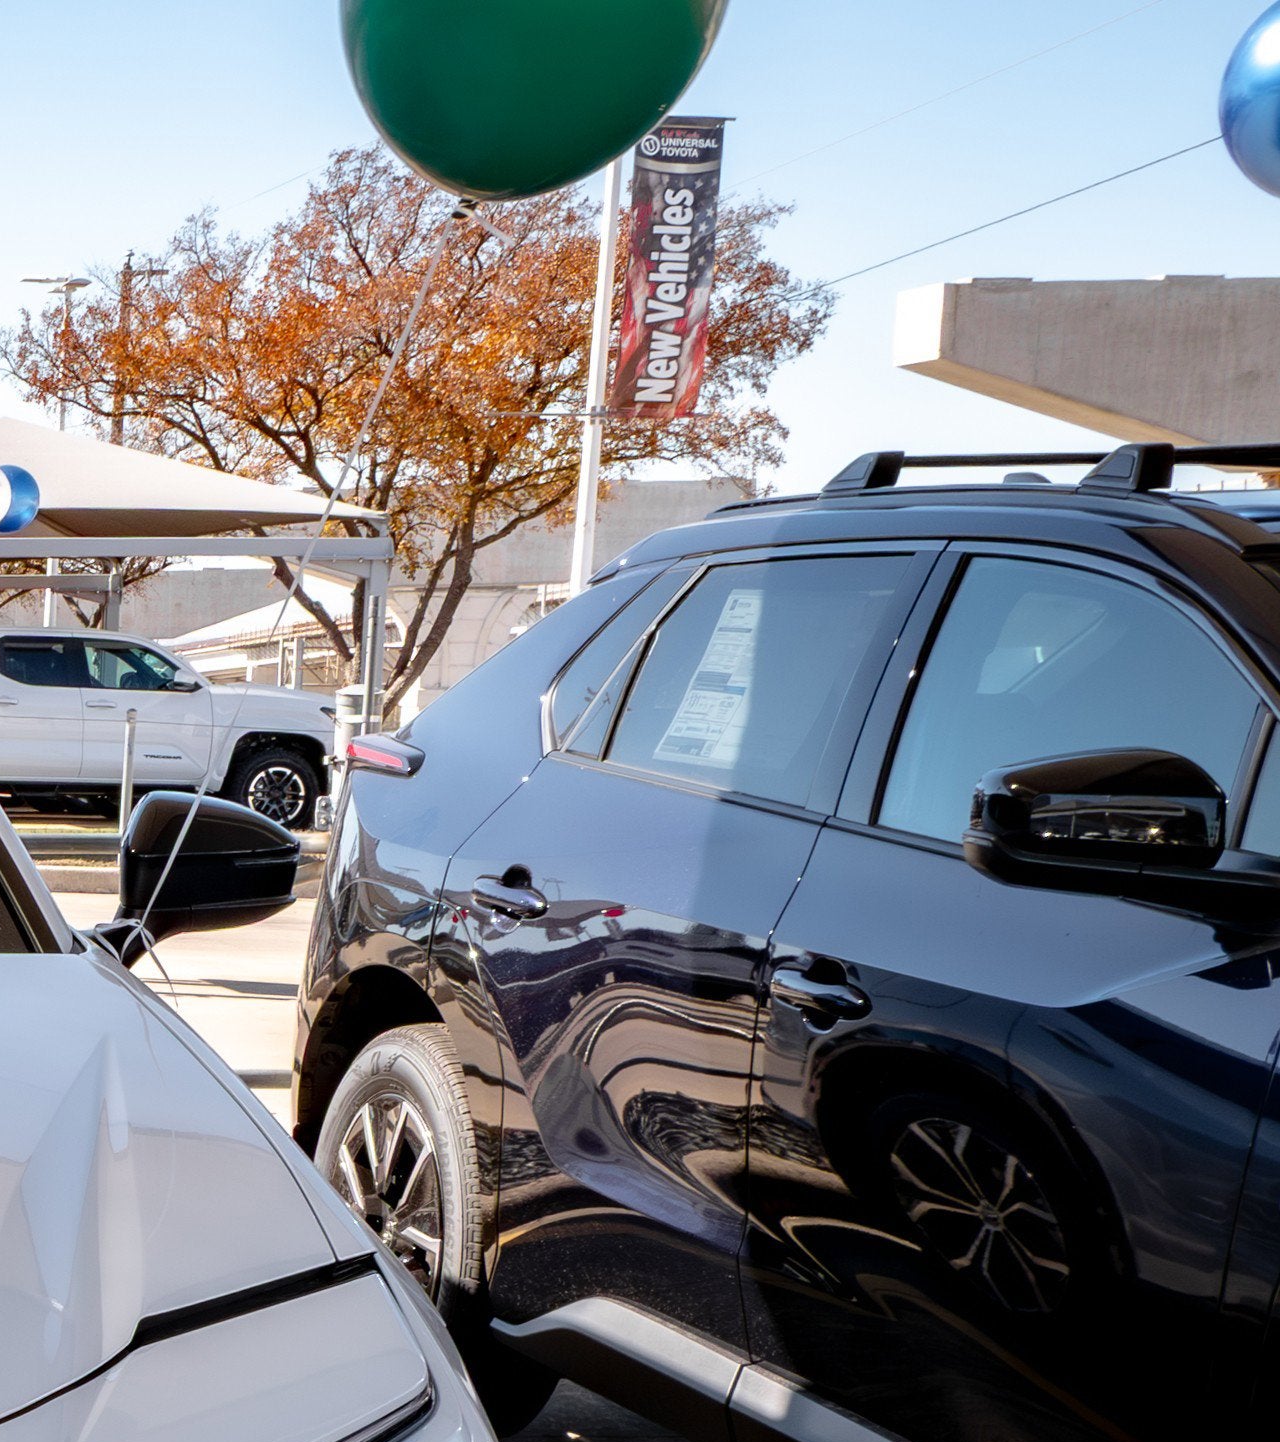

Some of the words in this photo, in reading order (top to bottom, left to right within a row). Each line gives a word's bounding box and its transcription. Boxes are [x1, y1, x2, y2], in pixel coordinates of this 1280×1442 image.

[661, 137, 718, 149] UNIVERSAL
[661, 147, 699, 158] TOYOTA
[645, 187, 695, 325] Vehicles
[634, 333, 679, 404] New
